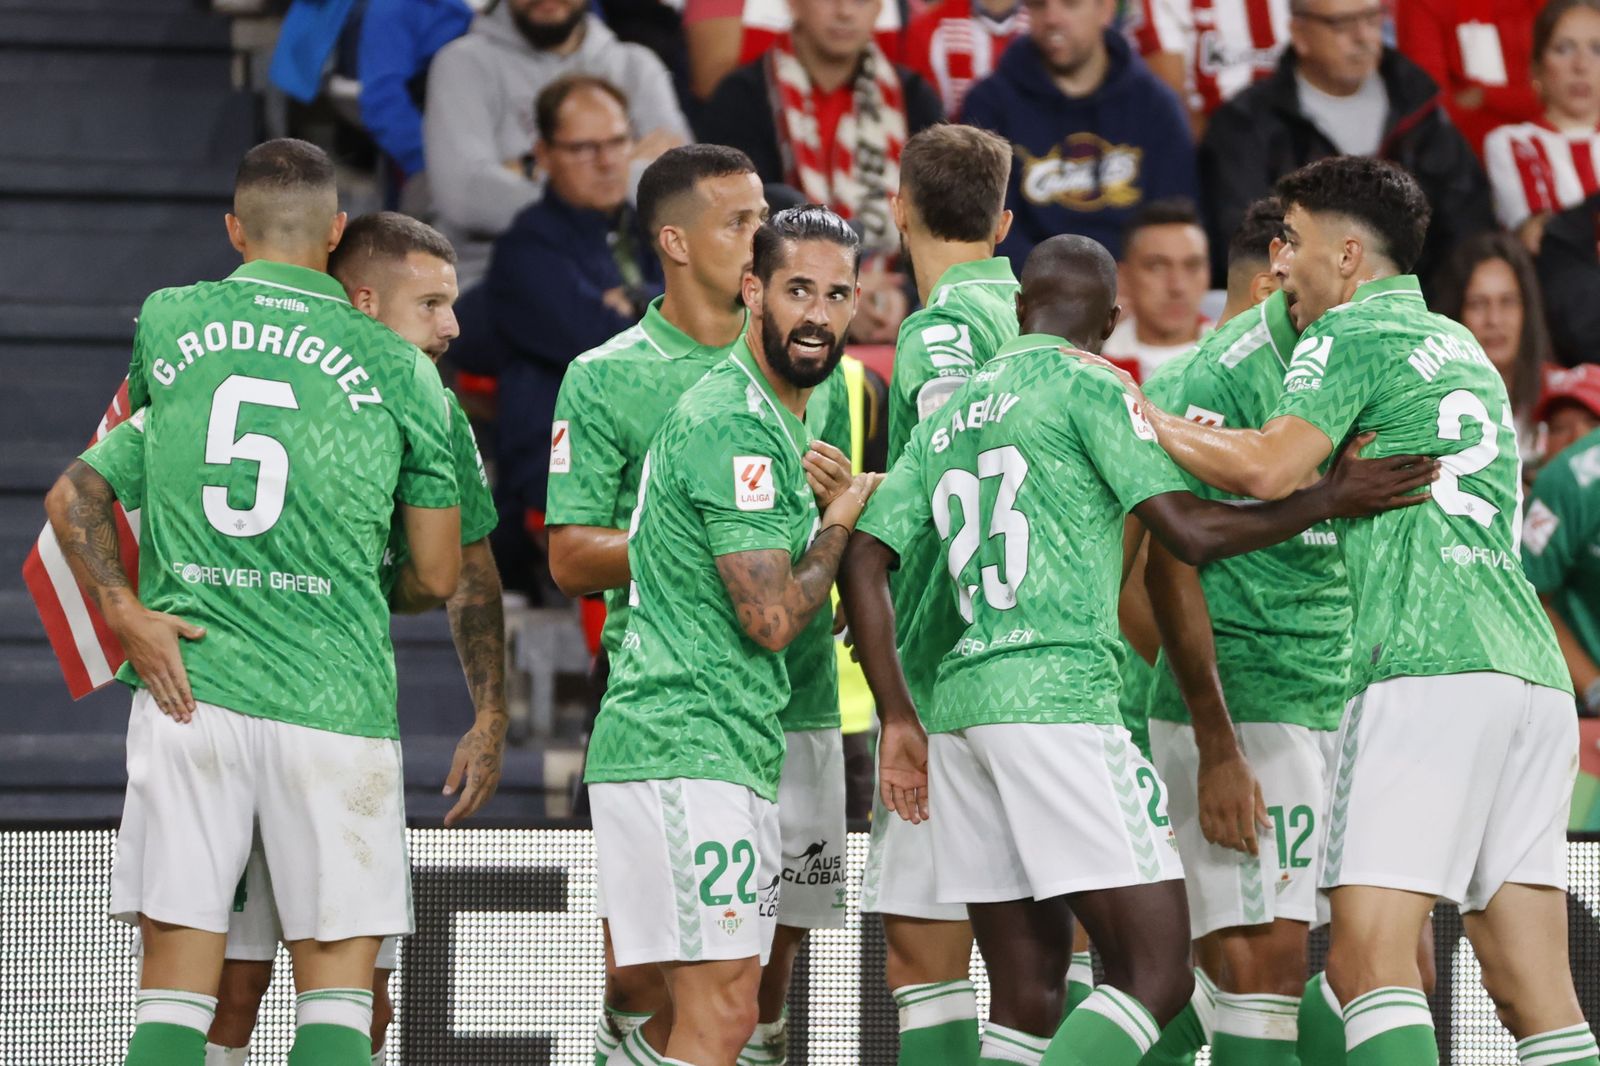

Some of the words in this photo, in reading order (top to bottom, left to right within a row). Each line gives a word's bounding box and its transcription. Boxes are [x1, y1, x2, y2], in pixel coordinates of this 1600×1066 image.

[152, 320, 383, 413] G.RODRÍGUEZ
[202, 373, 300, 538] 5
[741, 493, 771, 503] LALIGA
[931, 444, 1030, 624] 23
[172, 562, 262, 588] FOREVER
[270, 571, 331, 596] GREEN
[811, 855, 841, 871] AUS
[1266, 804, 1315, 870] 12
[694, 838, 757, 906] 22
[781, 866, 847, 885] GLOBAL
